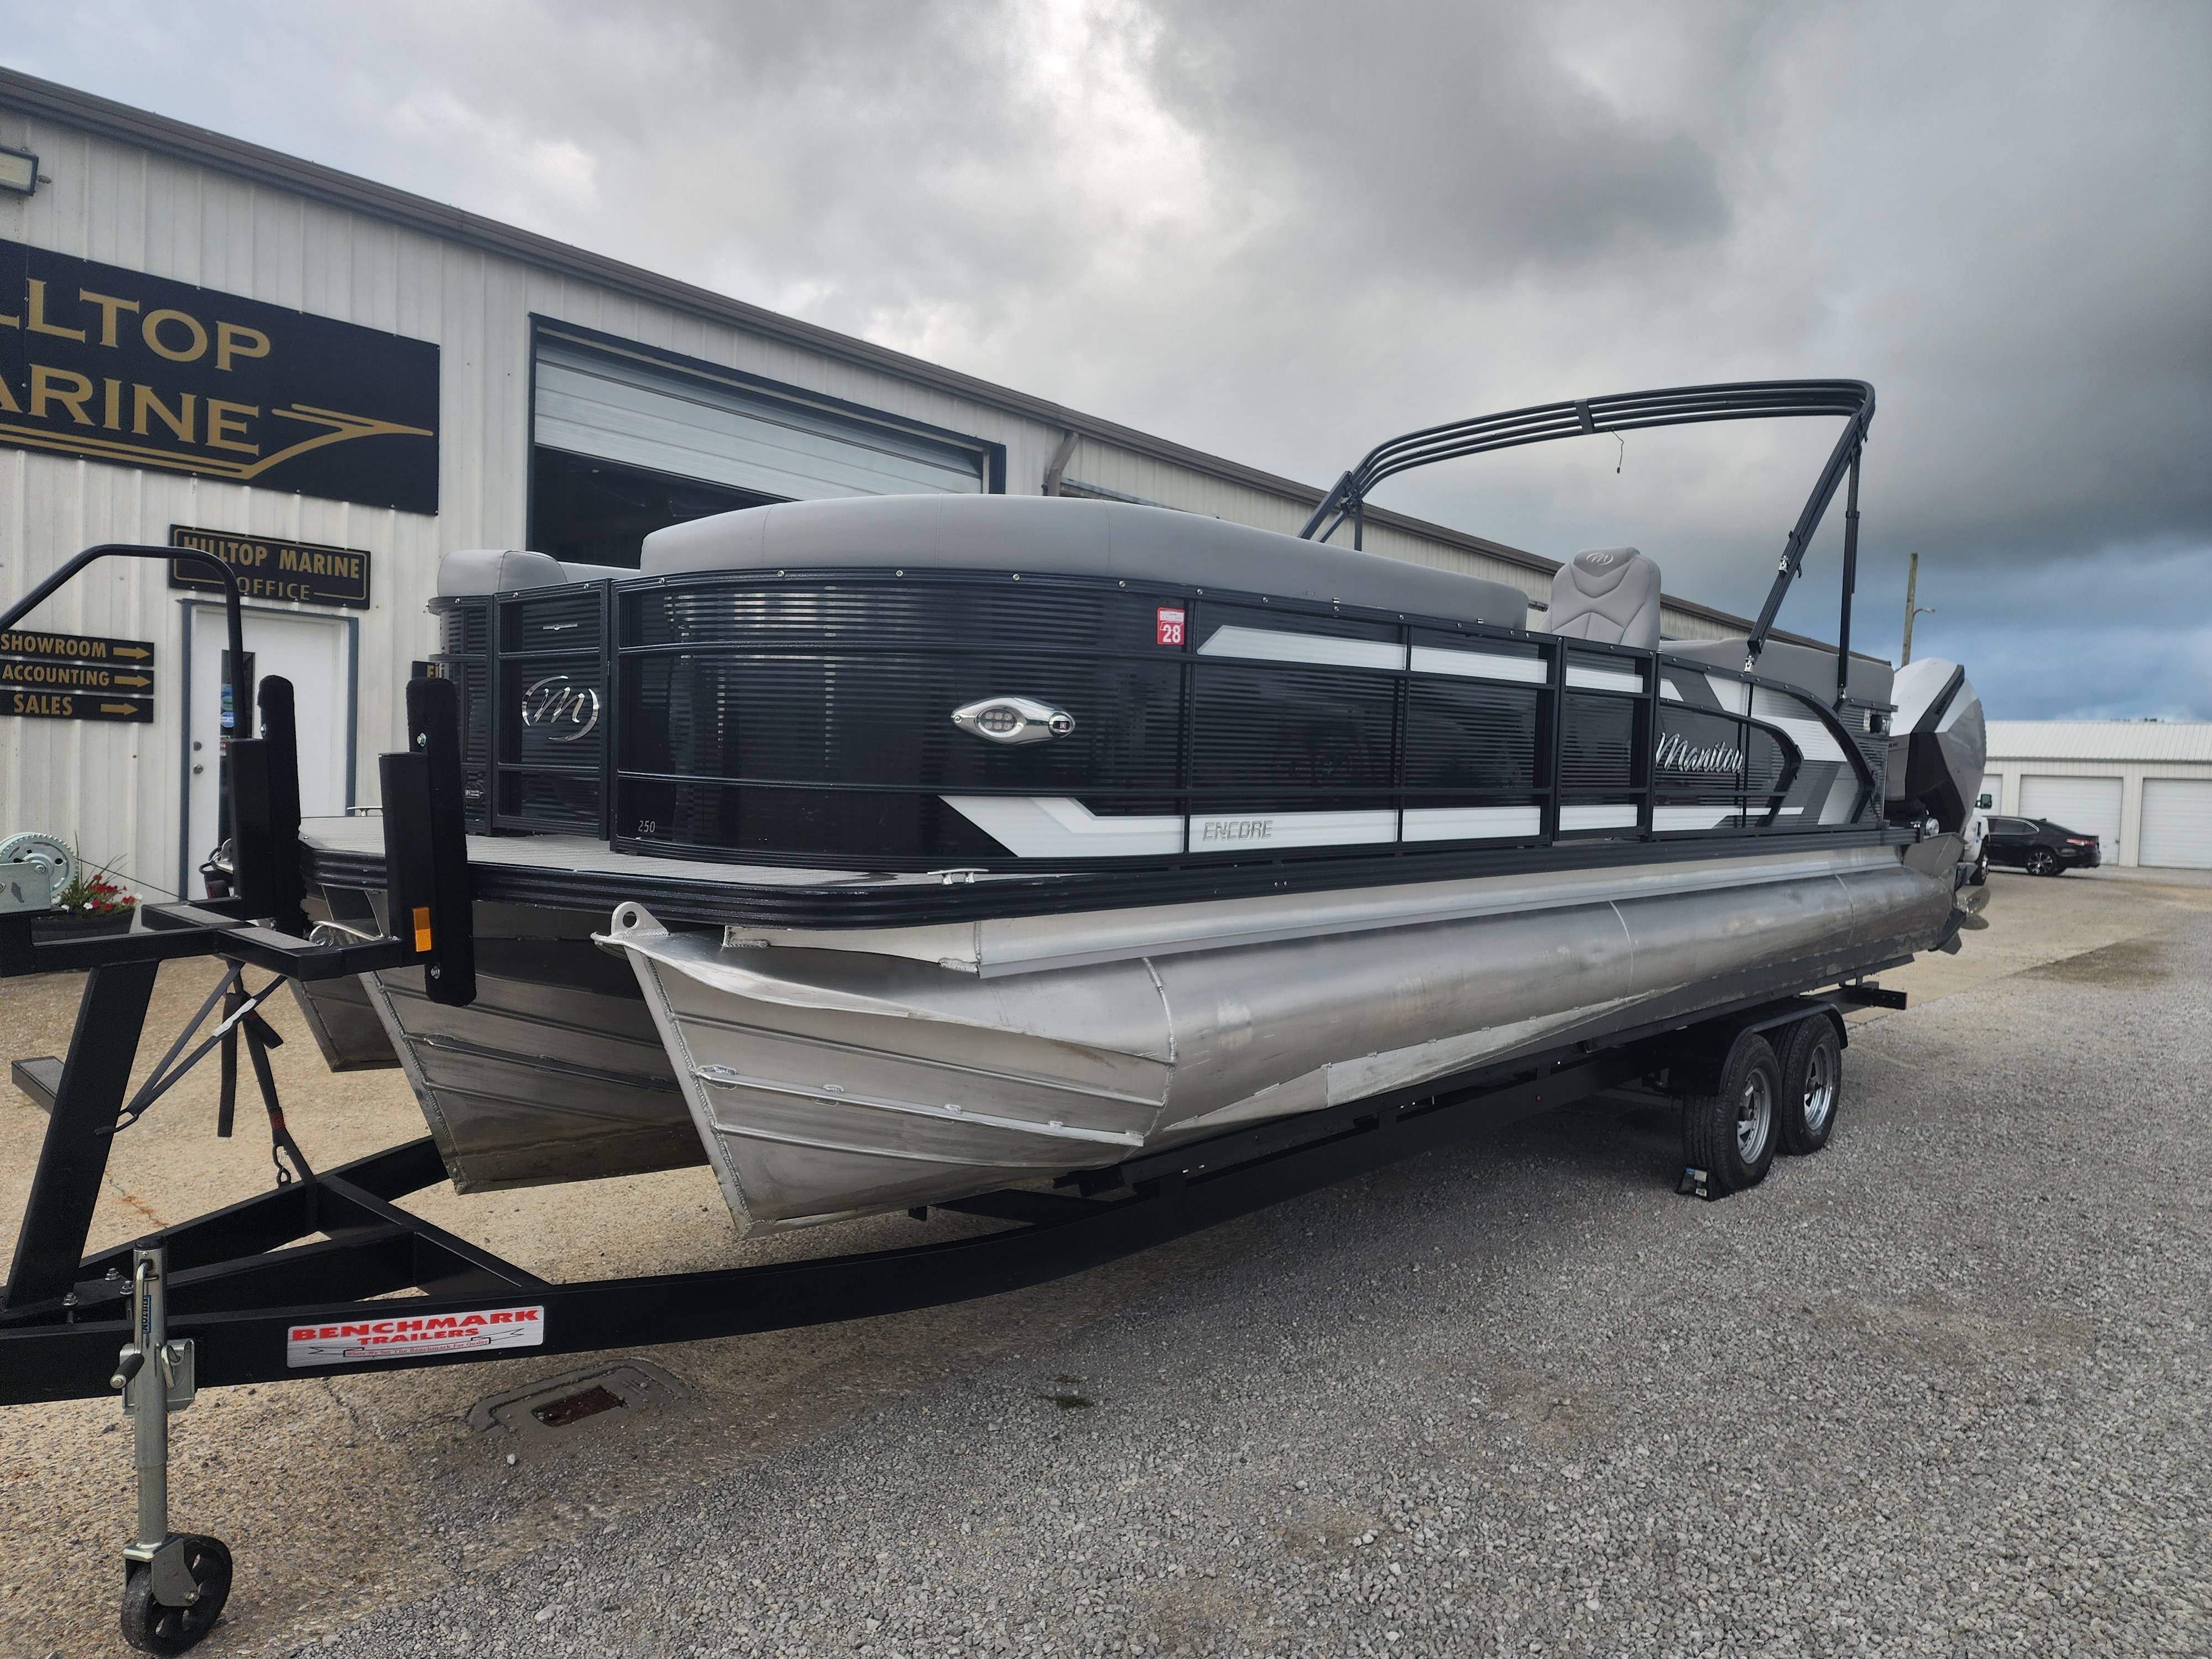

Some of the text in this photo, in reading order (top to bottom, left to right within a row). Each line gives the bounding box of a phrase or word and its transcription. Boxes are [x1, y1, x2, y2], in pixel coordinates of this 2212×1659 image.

[279, 549, 359, 580] MARINE
[236, 576, 310, 601] OFFICE
[1162, 624, 1181, 644] 28
[1, 633, 107, 658] SHOWROOM
[2, 665, 110, 687] ACCOUNTING
[13, 693, 73, 716] SALES
[1656, 732, 1743, 774] Manitou
[638, 820, 655, 833] 250
[1202, 820, 1274, 842] ENCORE
[291, 1310, 539, 1342] BENCHMARK
[357, 1327, 479, 1346] TRAILERS
[410, 1344, 451, 1353] Benchmark
